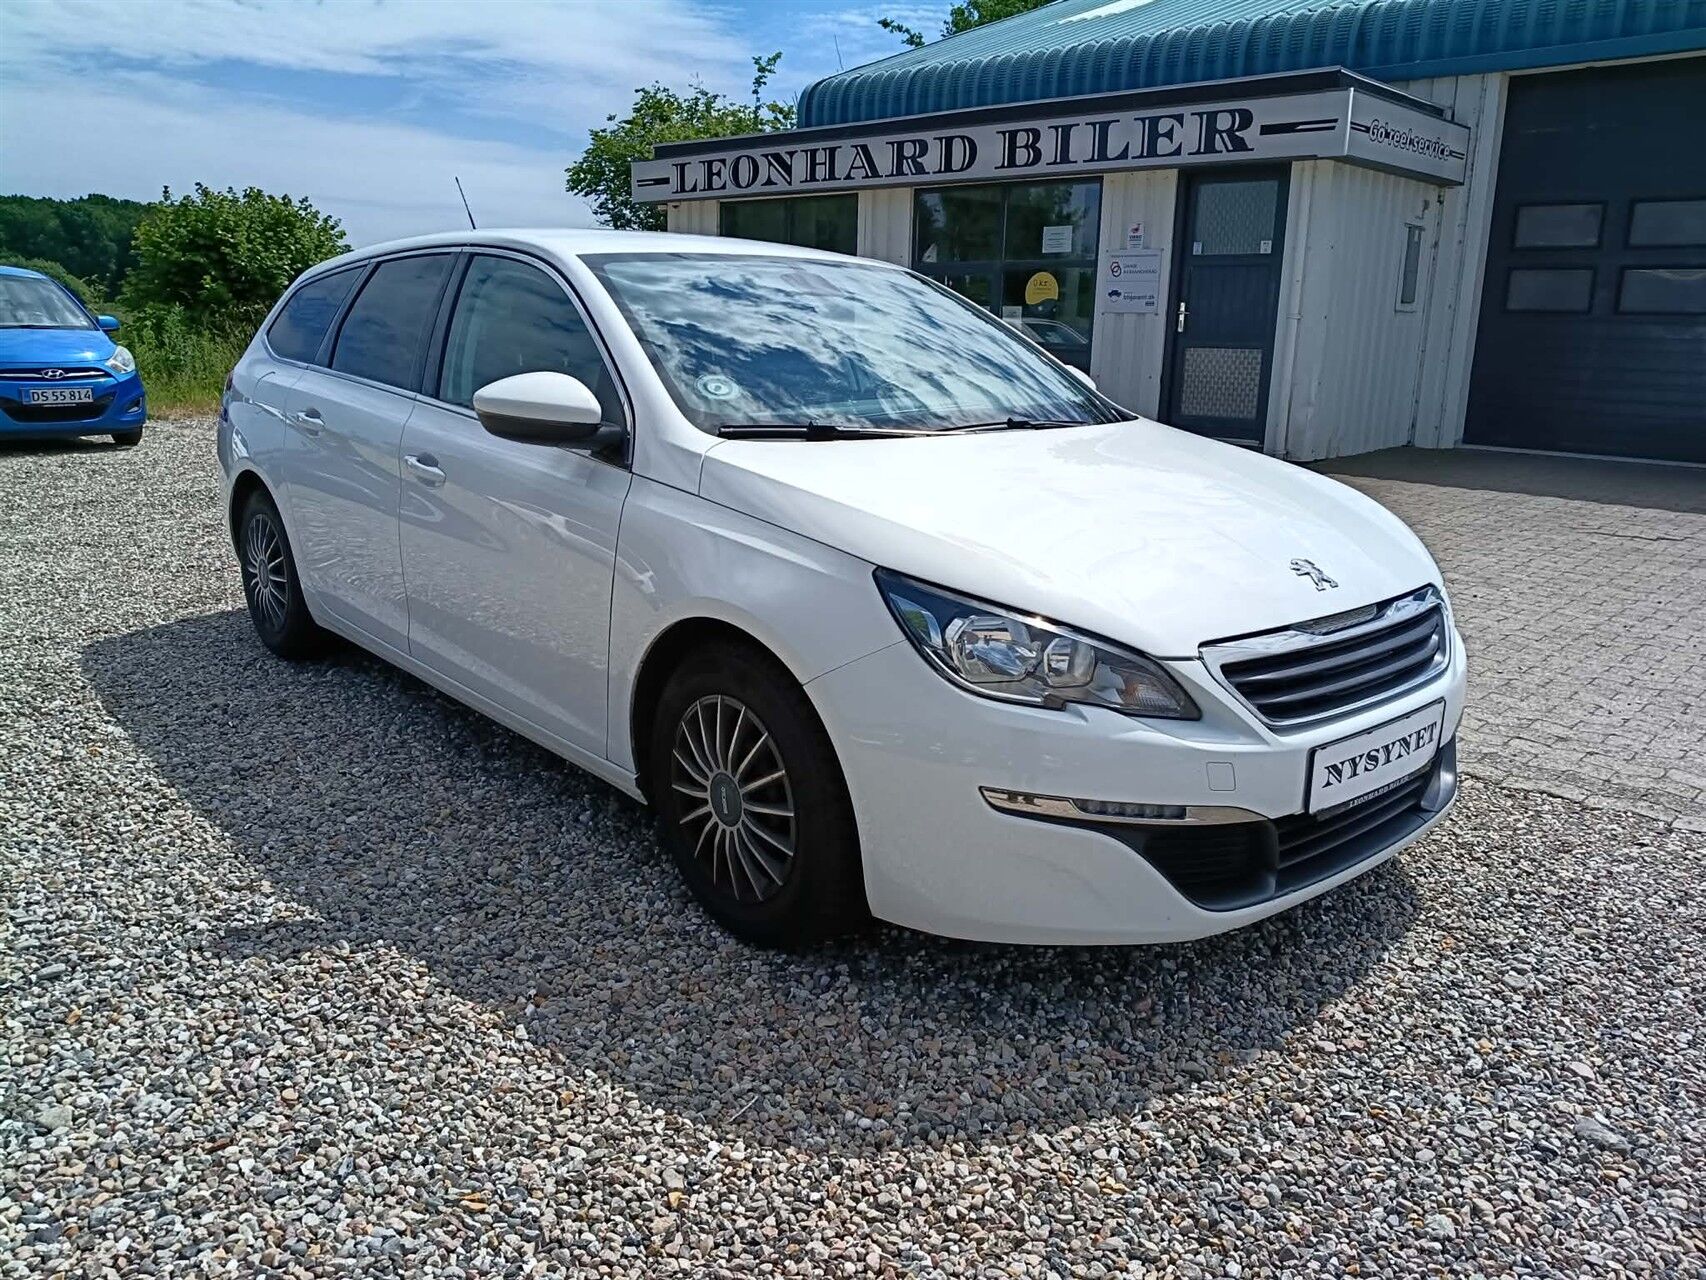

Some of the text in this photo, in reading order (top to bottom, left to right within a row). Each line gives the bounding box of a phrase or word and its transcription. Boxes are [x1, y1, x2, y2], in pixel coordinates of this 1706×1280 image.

[672, 107, 1255, 194] LEONHARD BILER
[1389, 128, 1413, 150] reel
[1412, 136, 1450, 161] service
[32, 389, 91, 402] DS 55 814
[1322, 721, 1437, 788] NYSYNET
